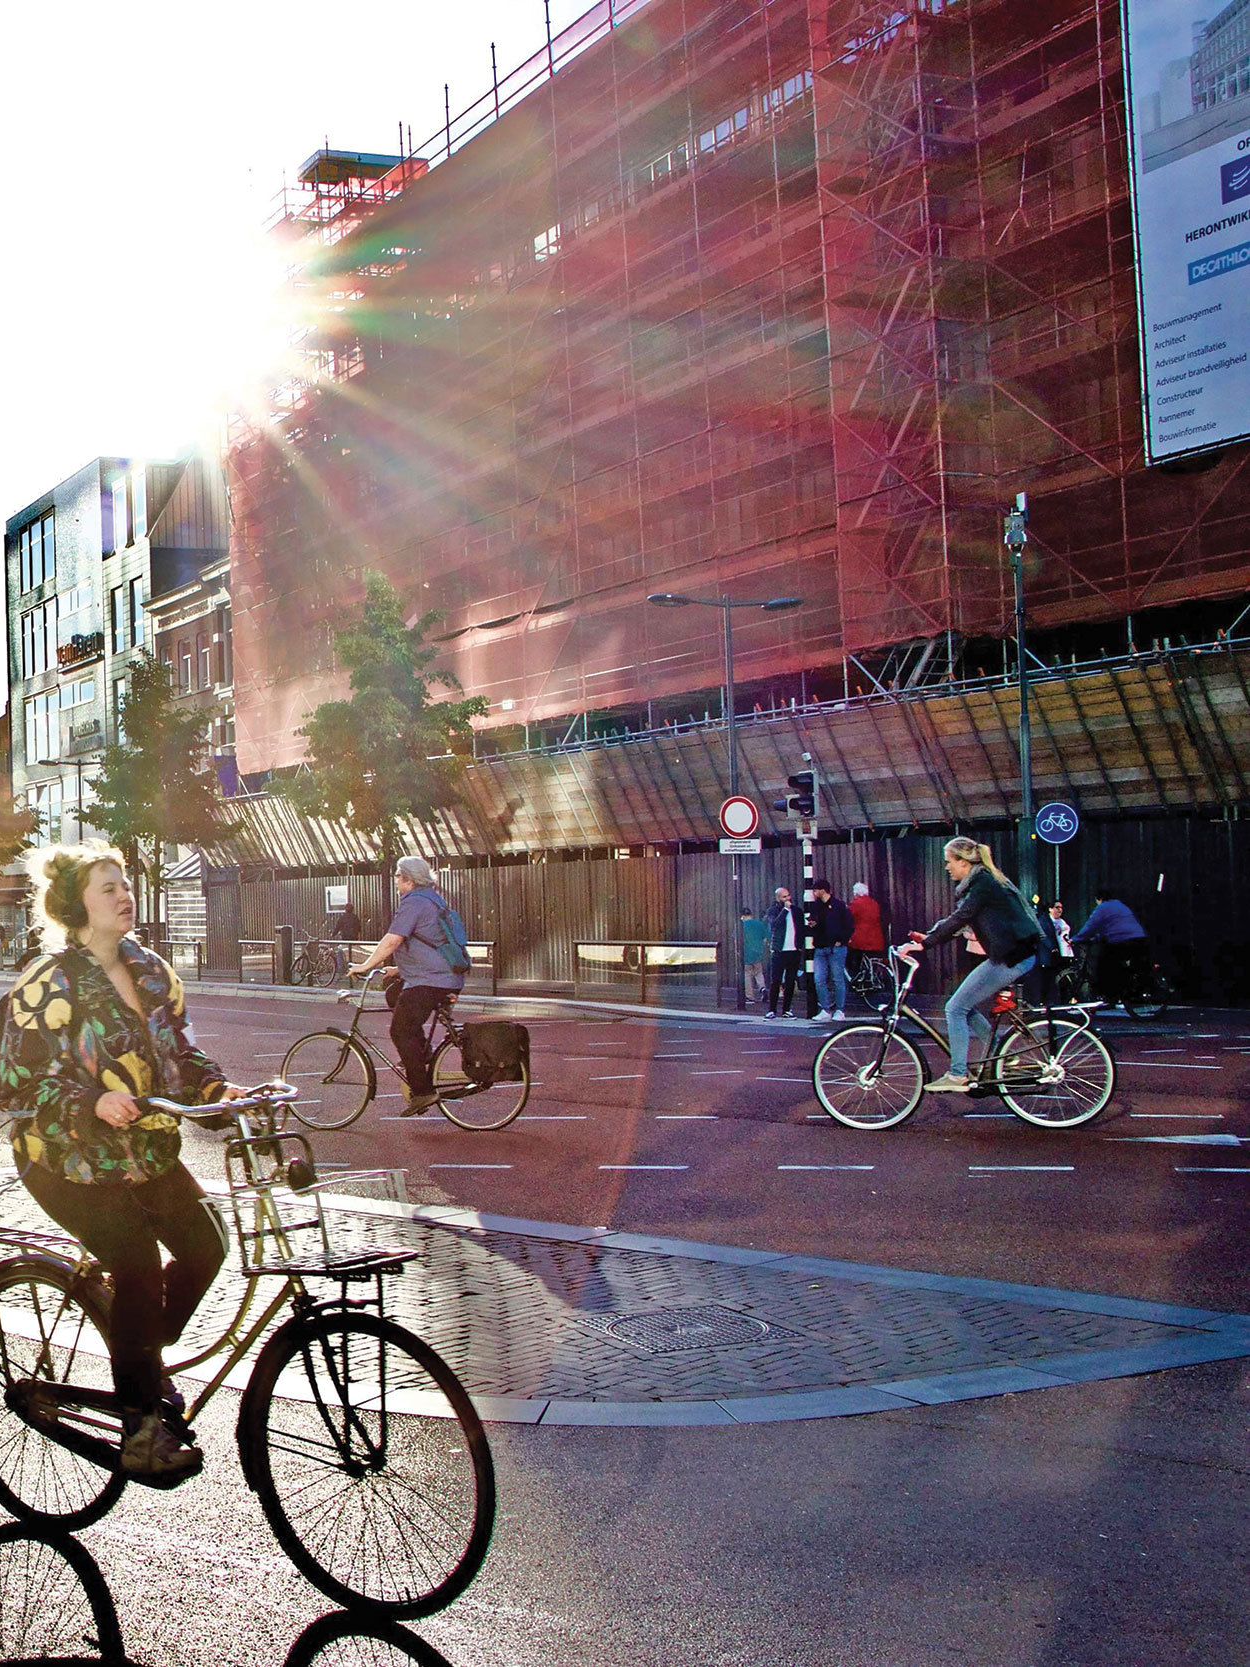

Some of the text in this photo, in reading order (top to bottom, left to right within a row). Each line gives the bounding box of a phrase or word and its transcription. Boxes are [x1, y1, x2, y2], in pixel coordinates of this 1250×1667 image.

[1191, 248, 1250, 279] DECATHLO
[1152, 303, 1222, 332] Bouwmanagement
[1153, 334, 1187, 351] Architect
[1154, 341, 1227, 369] Adviseur installaties
[1155, 352, 1247, 388] Adviseur brandveiligheid
[1156, 386, 1204, 406] Constructeur
[1157, 407, 1196, 424] Aannemer
[1158, 421, 1217, 443] Bouwinformatie
